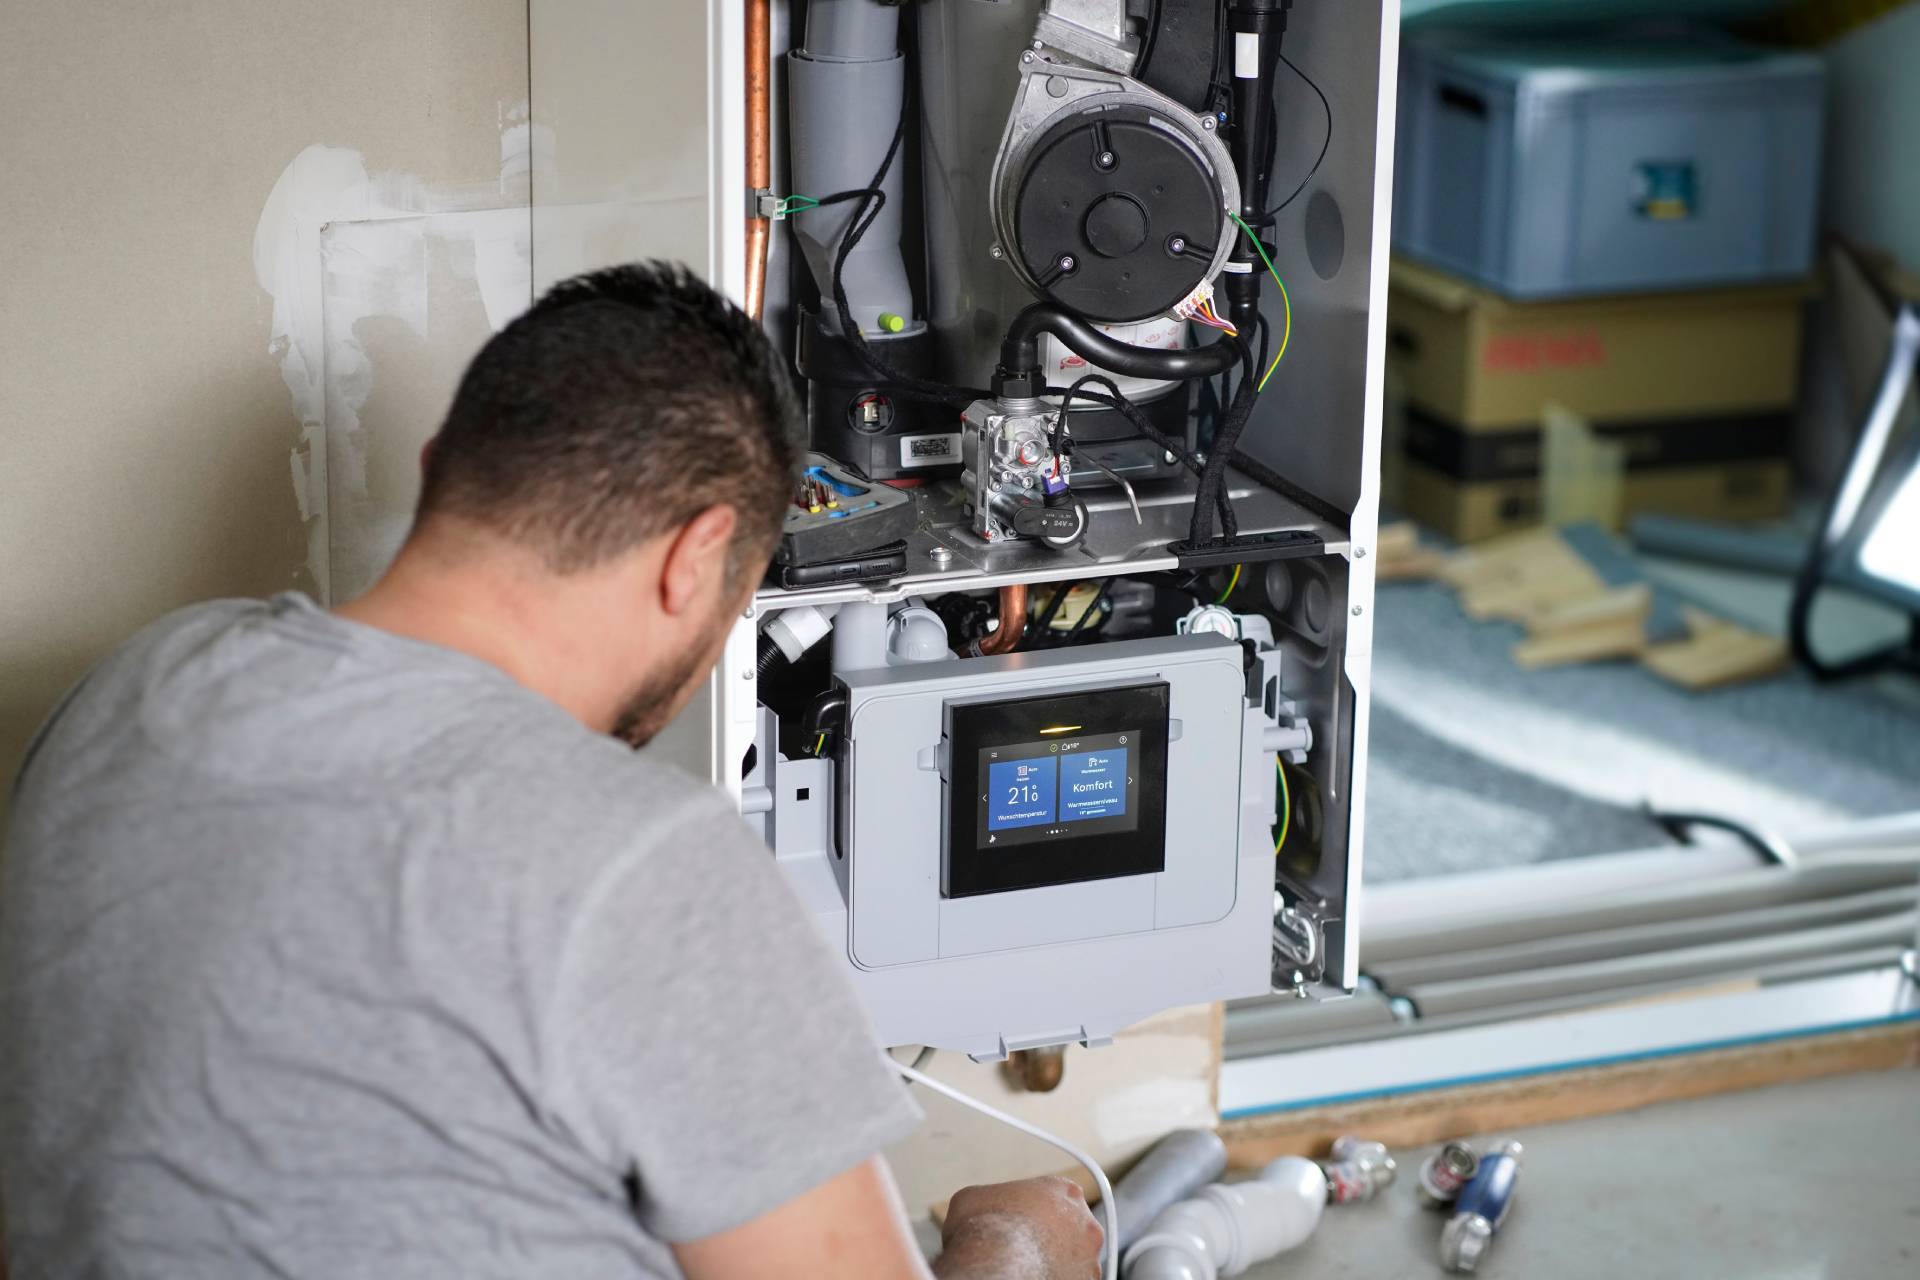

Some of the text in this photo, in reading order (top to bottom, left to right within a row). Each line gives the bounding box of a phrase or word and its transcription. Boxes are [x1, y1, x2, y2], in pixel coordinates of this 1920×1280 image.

[1073, 780, 1113, 793] Komfort
[1067, 798, 1118, 808] Warmwasserniveau
[998, 810, 1048, 821] Wunschtemperatur
